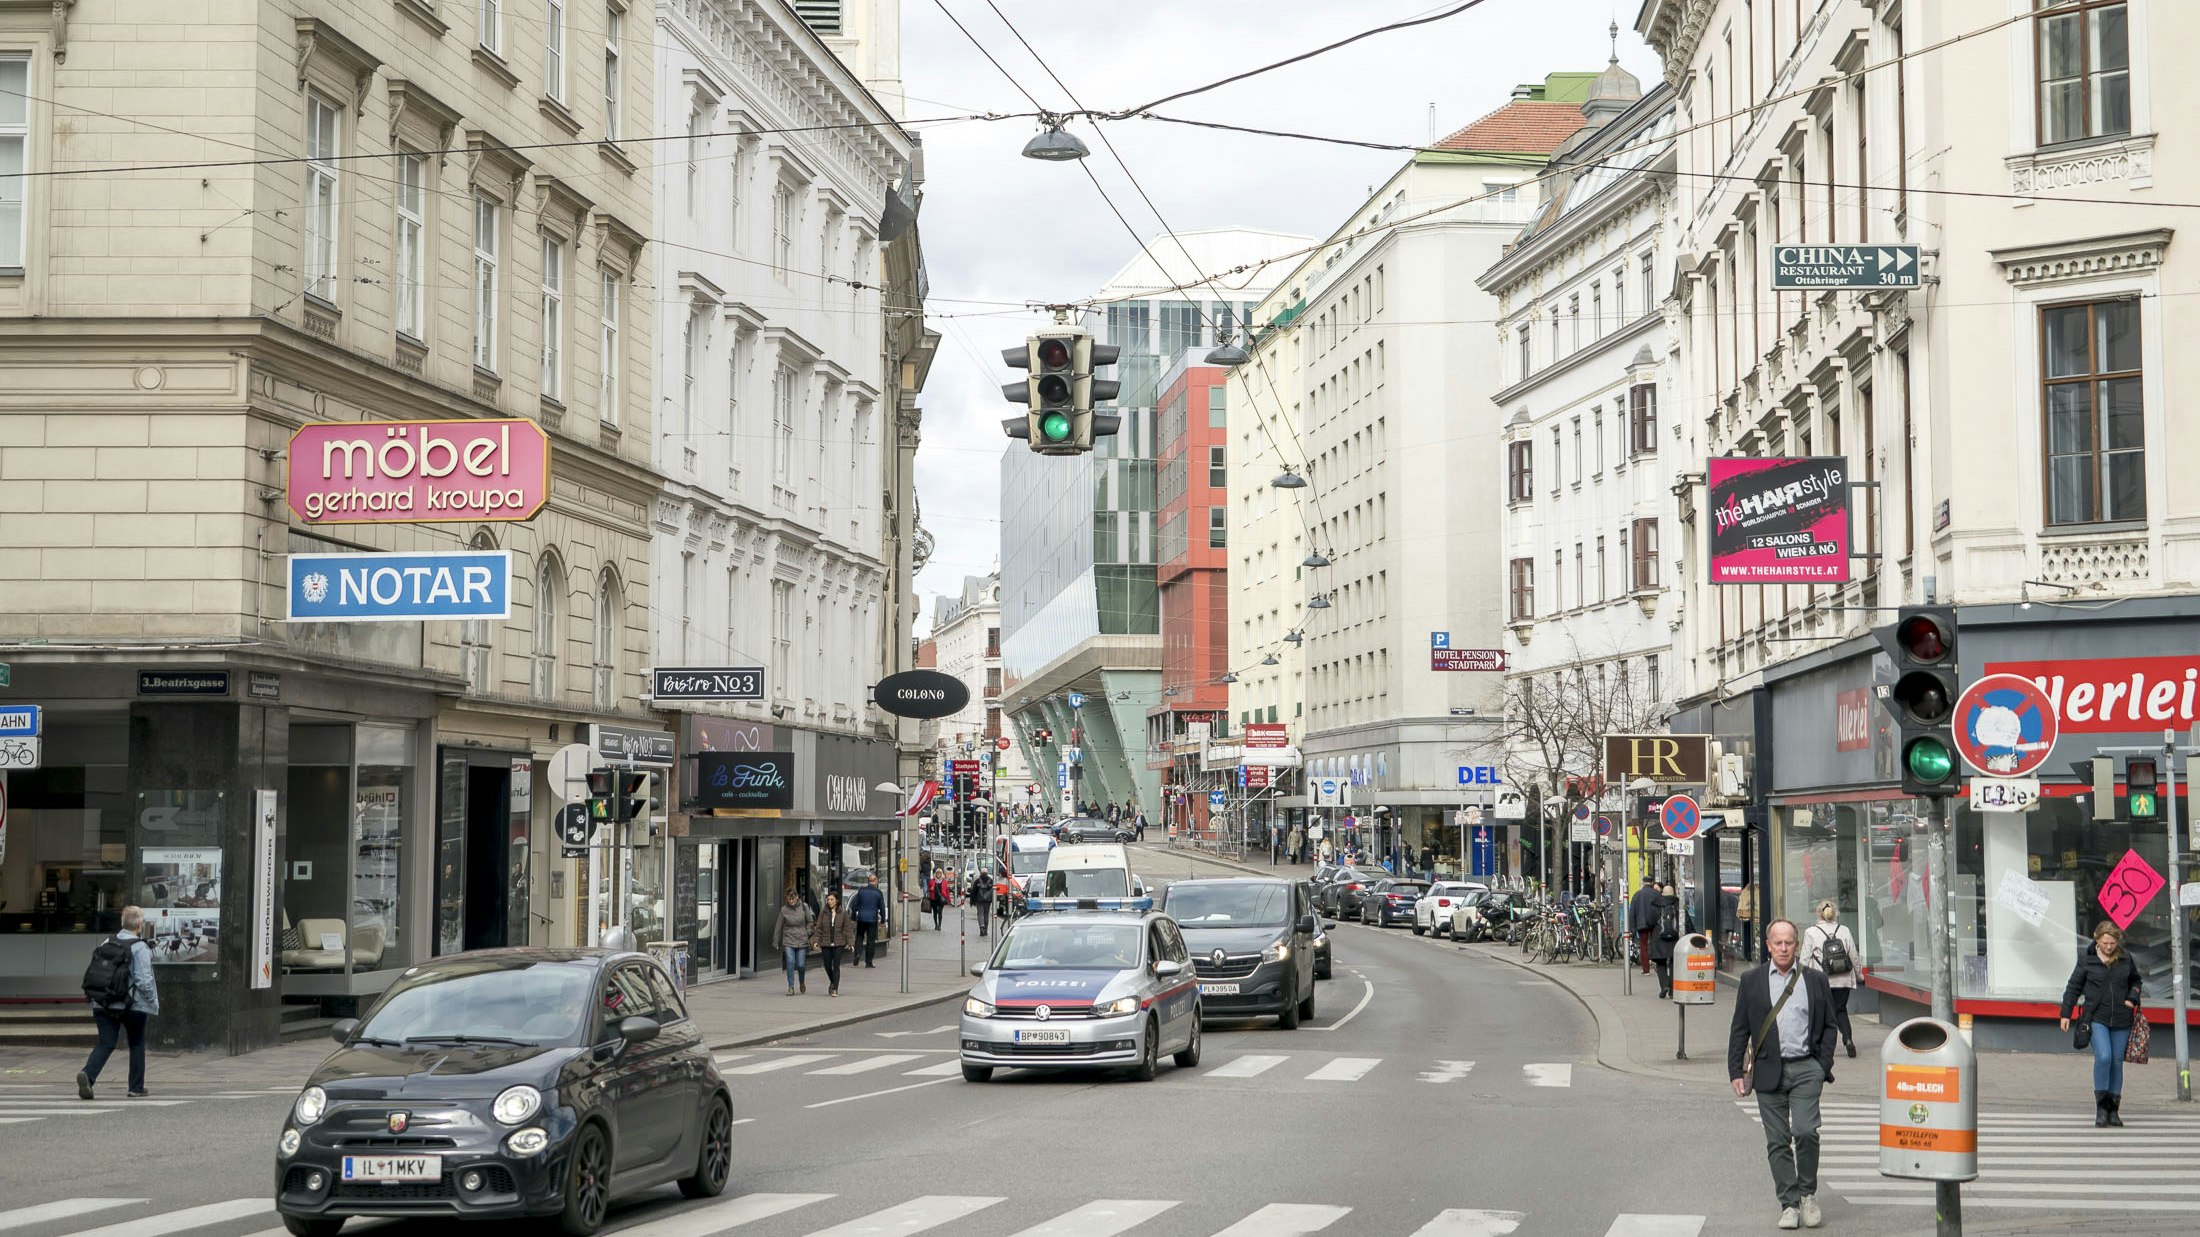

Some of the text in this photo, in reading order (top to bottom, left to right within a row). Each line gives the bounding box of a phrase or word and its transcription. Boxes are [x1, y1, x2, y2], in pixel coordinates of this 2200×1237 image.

[1779, 248, 1873, 265] CHINA-
[1780, 266, 1865, 276] RESTAURANT
[1878, 273, 1914, 285] 30 m
[322, 424, 511, 479] möbel
[304, 484, 525, 518] gerhard kroupa
[1796, 497, 1822, 511] SCHAIDER
[1751, 533, 1811, 548] 12 SALONS
[1777, 541, 1836, 558] WIEN & NÖ
[1720, 566, 1839, 576] WWW.THEHAIRSTYLE.AT
[338, 566, 493, 606] NOTAR
[1434, 650, 1495, 660] HOTEL PENSION
[1448, 660, 1495, 670] STADTPARK
[663, 675, 712, 693] Bistro
[897, 688, 945, 700] COLONO
[2035, 667, 2198, 722] llerlei
[1837, 697, 1868, 743] Allerlei
[1628, 738, 1687, 776] HR
[1458, 766, 1502, 784] DEL
[826, 773, 866, 812] COLONO
[1015, 980, 1087, 988] POLIZEI
[1169, 1001, 1186, 1019] POLIZEI
[1021, 1031, 1065, 1041] BP 90843
[363, 1160, 375, 1175] IL
